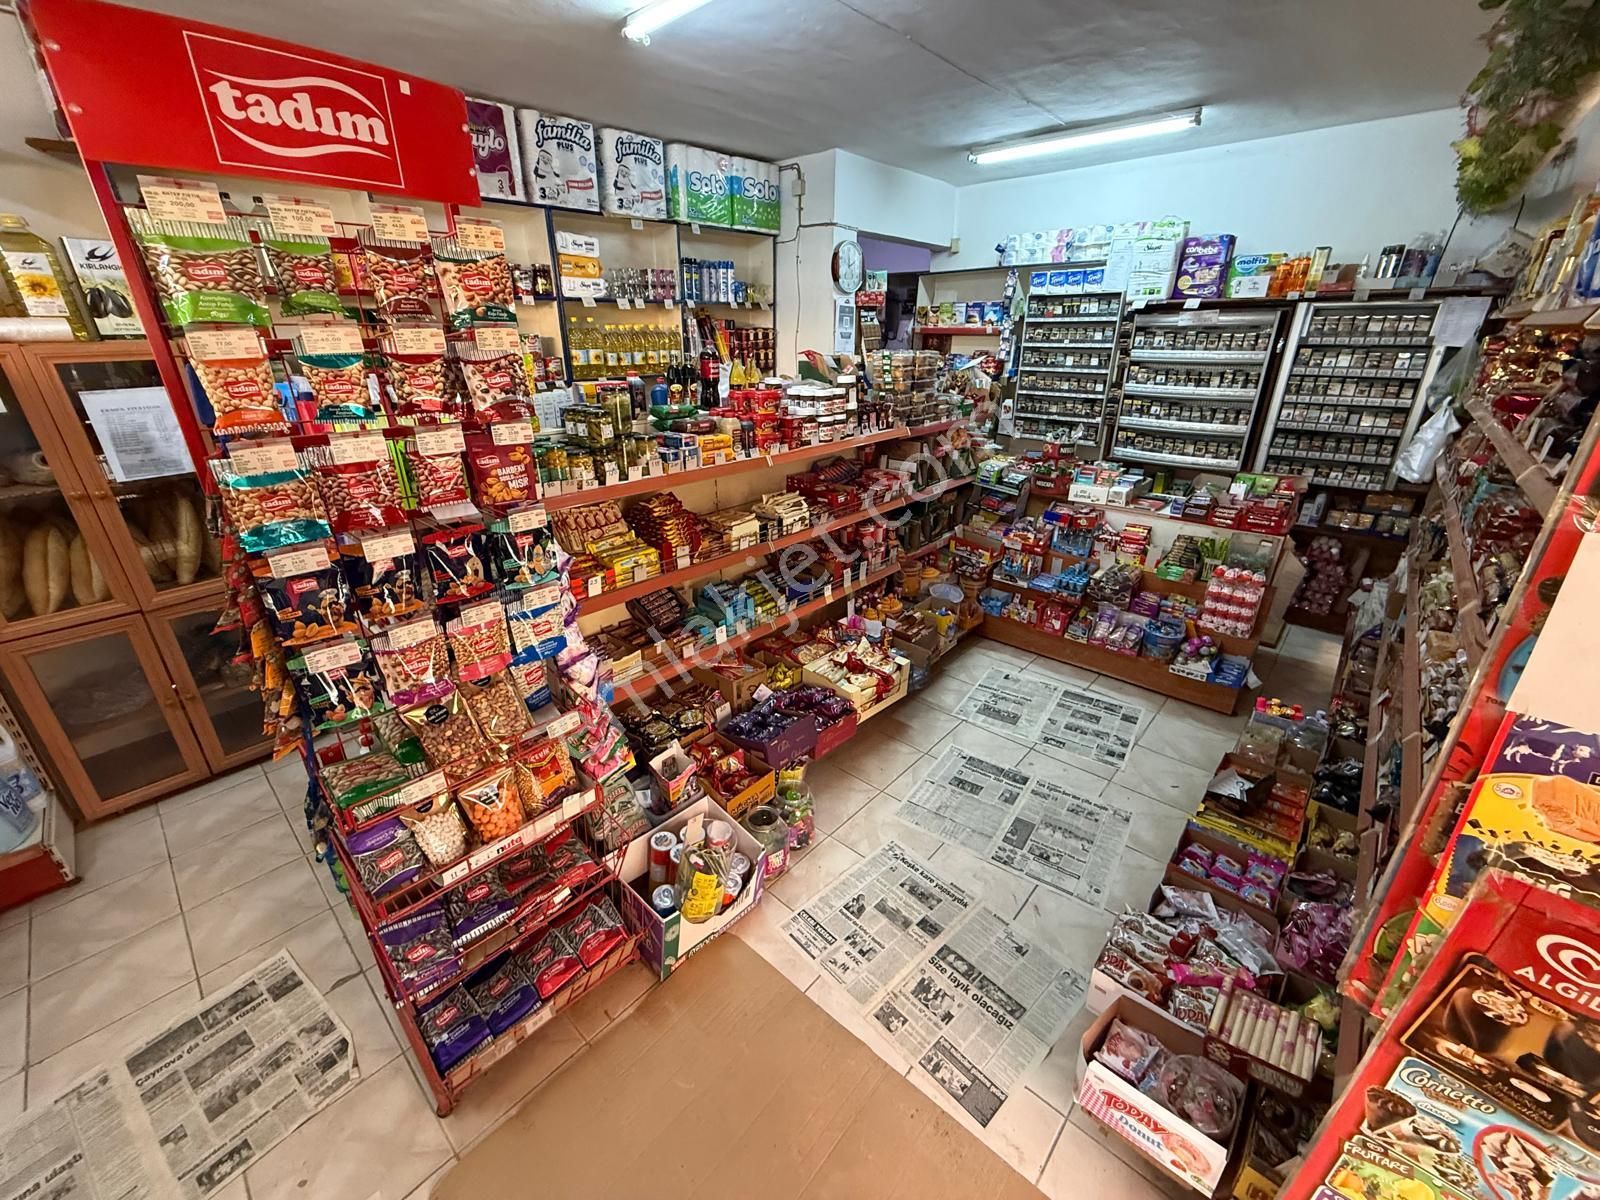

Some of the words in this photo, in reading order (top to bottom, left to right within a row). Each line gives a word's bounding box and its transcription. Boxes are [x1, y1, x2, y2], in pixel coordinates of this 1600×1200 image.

[209, 80, 390, 145] tadım
[536, 119, 592, 151] familia
[615, 136, 662, 165] familia
[539, 186, 547, 199] 3
[689, 171, 726, 196] Solo
[743, 176, 777, 202] Solo
[616, 198, 625, 210] 3
[187, 267, 225, 276] tadım
[1236, 256, 1269, 267] molfix
[464, 279, 490, 287] tadım
[228, 384, 260, 394] tadım
[324, 383, 352, 391] tadım
[927, 953, 951, 974] Size
[946, 969, 975, 994] layık
[968, 988, 1018, 1029] olacağız
[1400, 1067, 1497, 1114] Cornetto
[1100, 1089, 1170, 1134] TODAY
[1118, 1114, 1165, 1151] Donut
[1343, 1141, 1410, 1175] FRUTTARE
